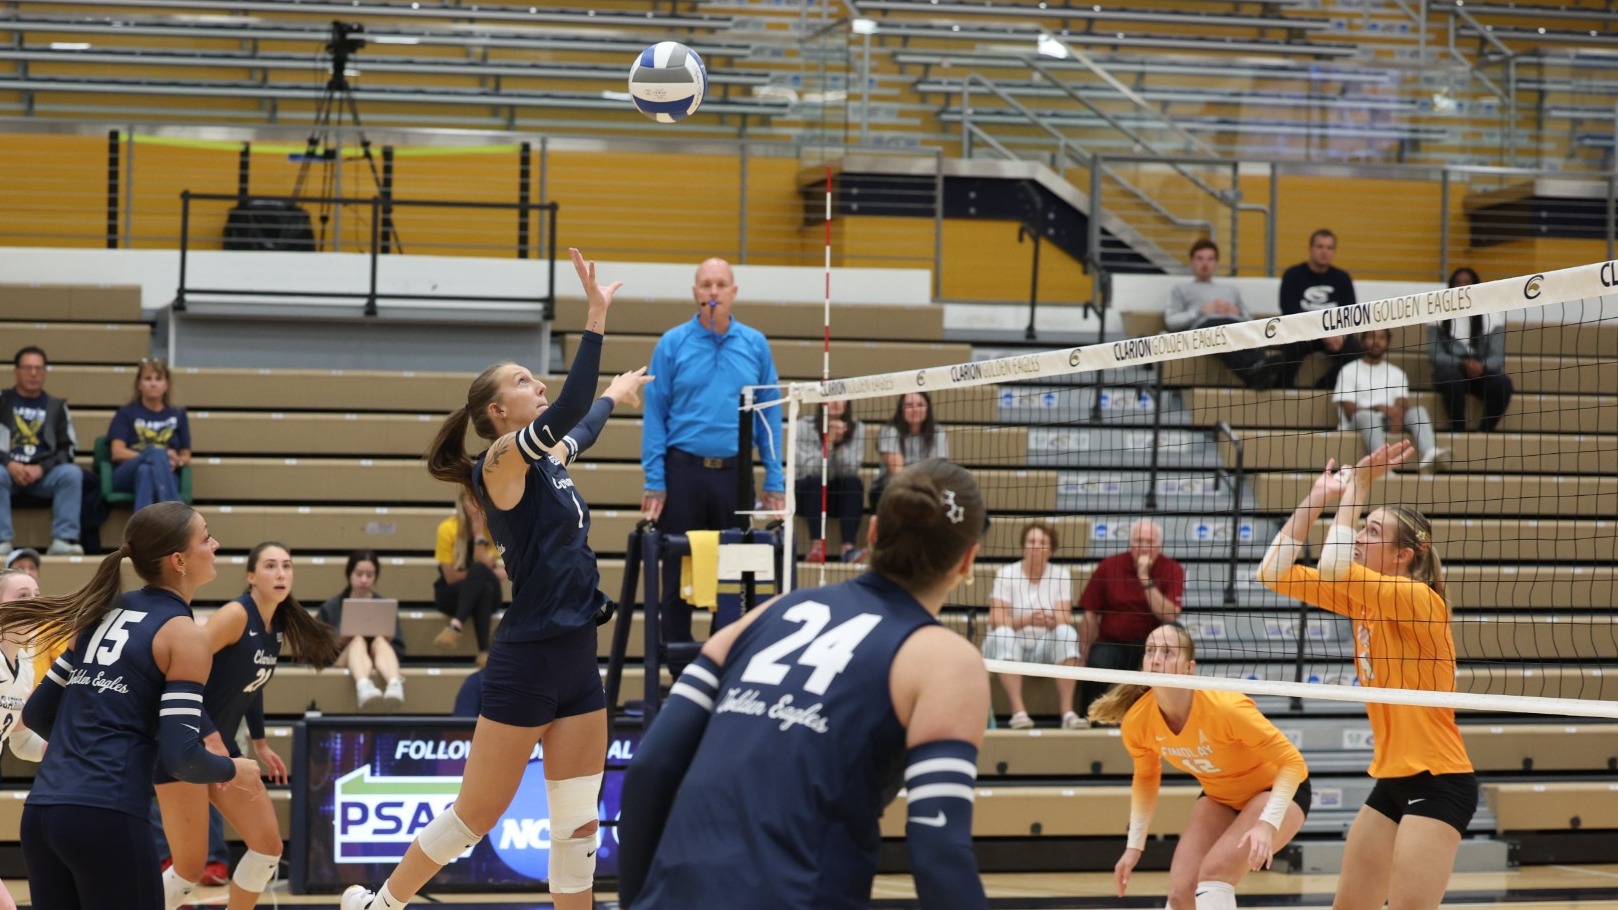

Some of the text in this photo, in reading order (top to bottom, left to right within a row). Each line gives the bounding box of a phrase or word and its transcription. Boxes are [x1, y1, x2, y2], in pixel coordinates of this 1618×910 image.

[1322, 287, 1472, 331] CLARION GOLDEN EAGLES
[1113, 325, 1227, 361] CLARION GOLDEN EAGLES
[951, 355, 1040, 382] CLARION GOLDEN EAGLES
[83, 608, 148, 666] 15
[741, 600, 883, 695] 24
[92, 671, 129, 693] Eagles
[768, 694, 829, 734] Eagles
[607, 740, 633, 760] AL
[1161, 744, 1214, 757] FINDLAY
[1181, 758, 1222, 773] 12
[340, 801, 455, 835] PSA
[499, 818, 551, 849] NC
